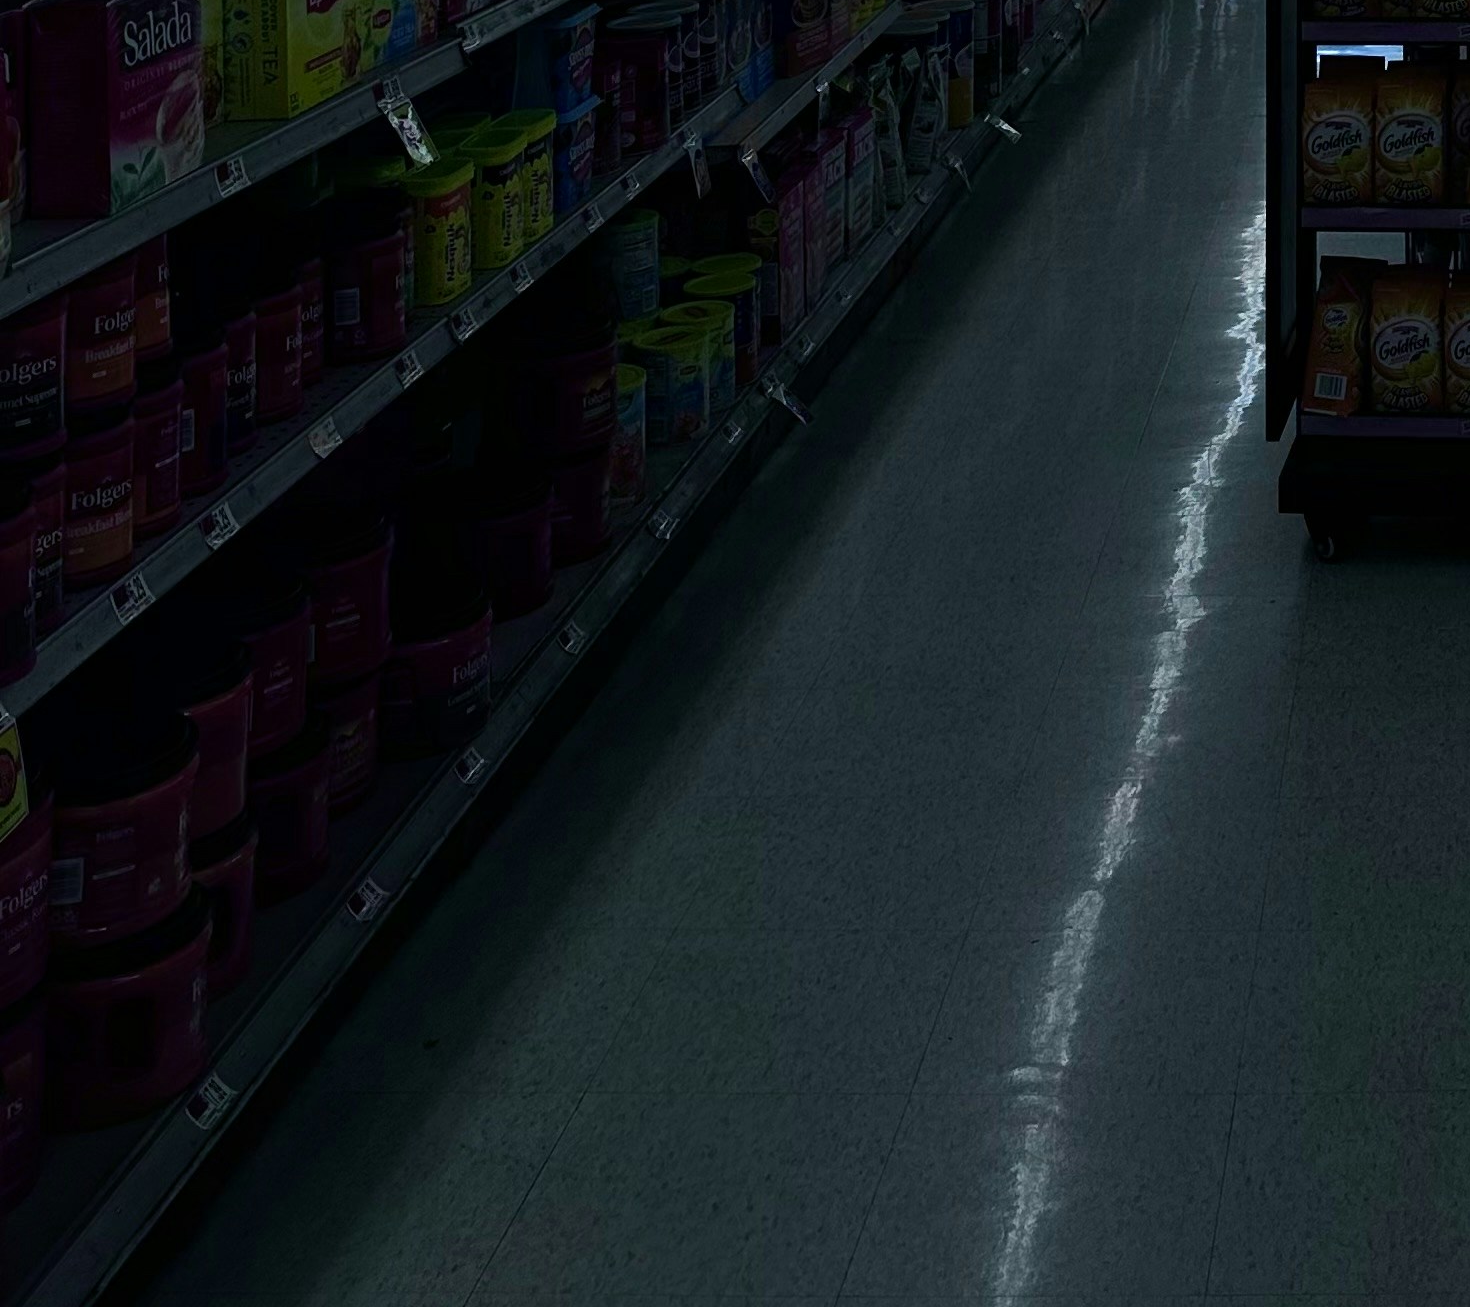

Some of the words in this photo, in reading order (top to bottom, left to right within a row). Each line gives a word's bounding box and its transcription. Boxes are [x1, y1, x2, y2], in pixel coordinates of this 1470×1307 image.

[124, 0, 191, 66] Salada
[263, 46, 278, 85] TEA
[1311, 130, 1363, 155] Goldfish
[1382, 130, 1435, 154] Goldfish
[1314, 188, 1359, 203] BLASTED
[1386, 187, 1430, 202] BLASTED
[503, 192, 511, 247] Nesquik
[446, 224, 455, 281] Nesquik
[94, 307, 136, 335] Folge
[1379, 334, 1431, 360] Goldfish
[0, 355, 57, 385] olgers
[1383, 392, 1428, 410] BLASTED
[71, 478, 133, 511] Folgers
